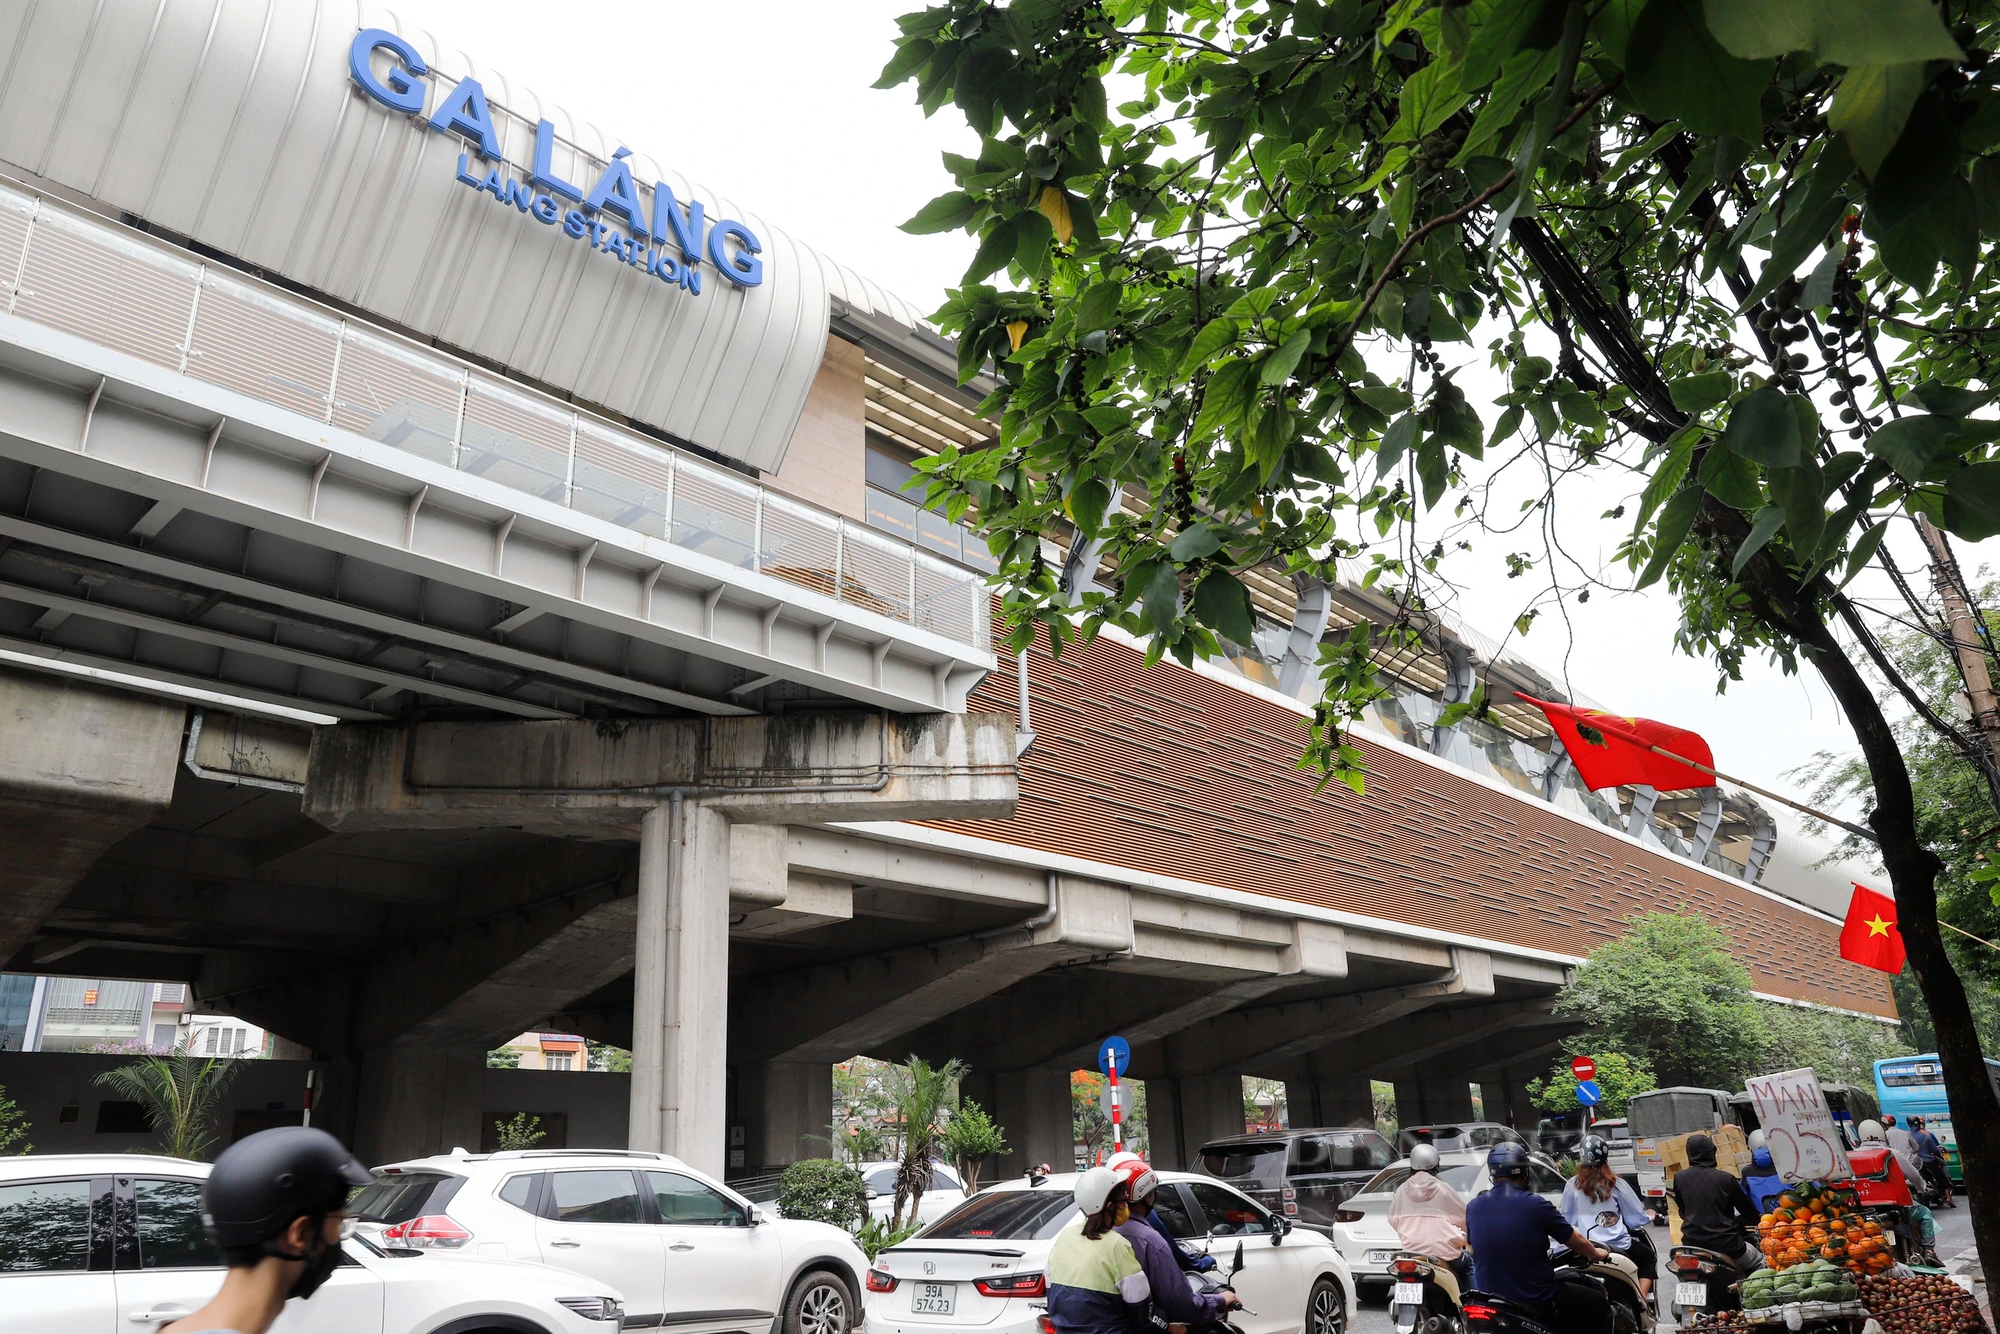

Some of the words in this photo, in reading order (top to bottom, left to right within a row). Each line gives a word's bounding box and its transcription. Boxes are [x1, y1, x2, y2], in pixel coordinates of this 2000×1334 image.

[349, 27, 503, 163] GA
[528, 146, 763, 288] LÁNG
[456, 151, 559, 225] LANG
[562, 209, 702, 297] STATION
[1768, 1122, 1836, 1181] 25
[916, 1298, 950, 1313] 574.23
[925, 1285, 943, 1298] 99A
[1396, 1293, 1421, 1303] 406.24
